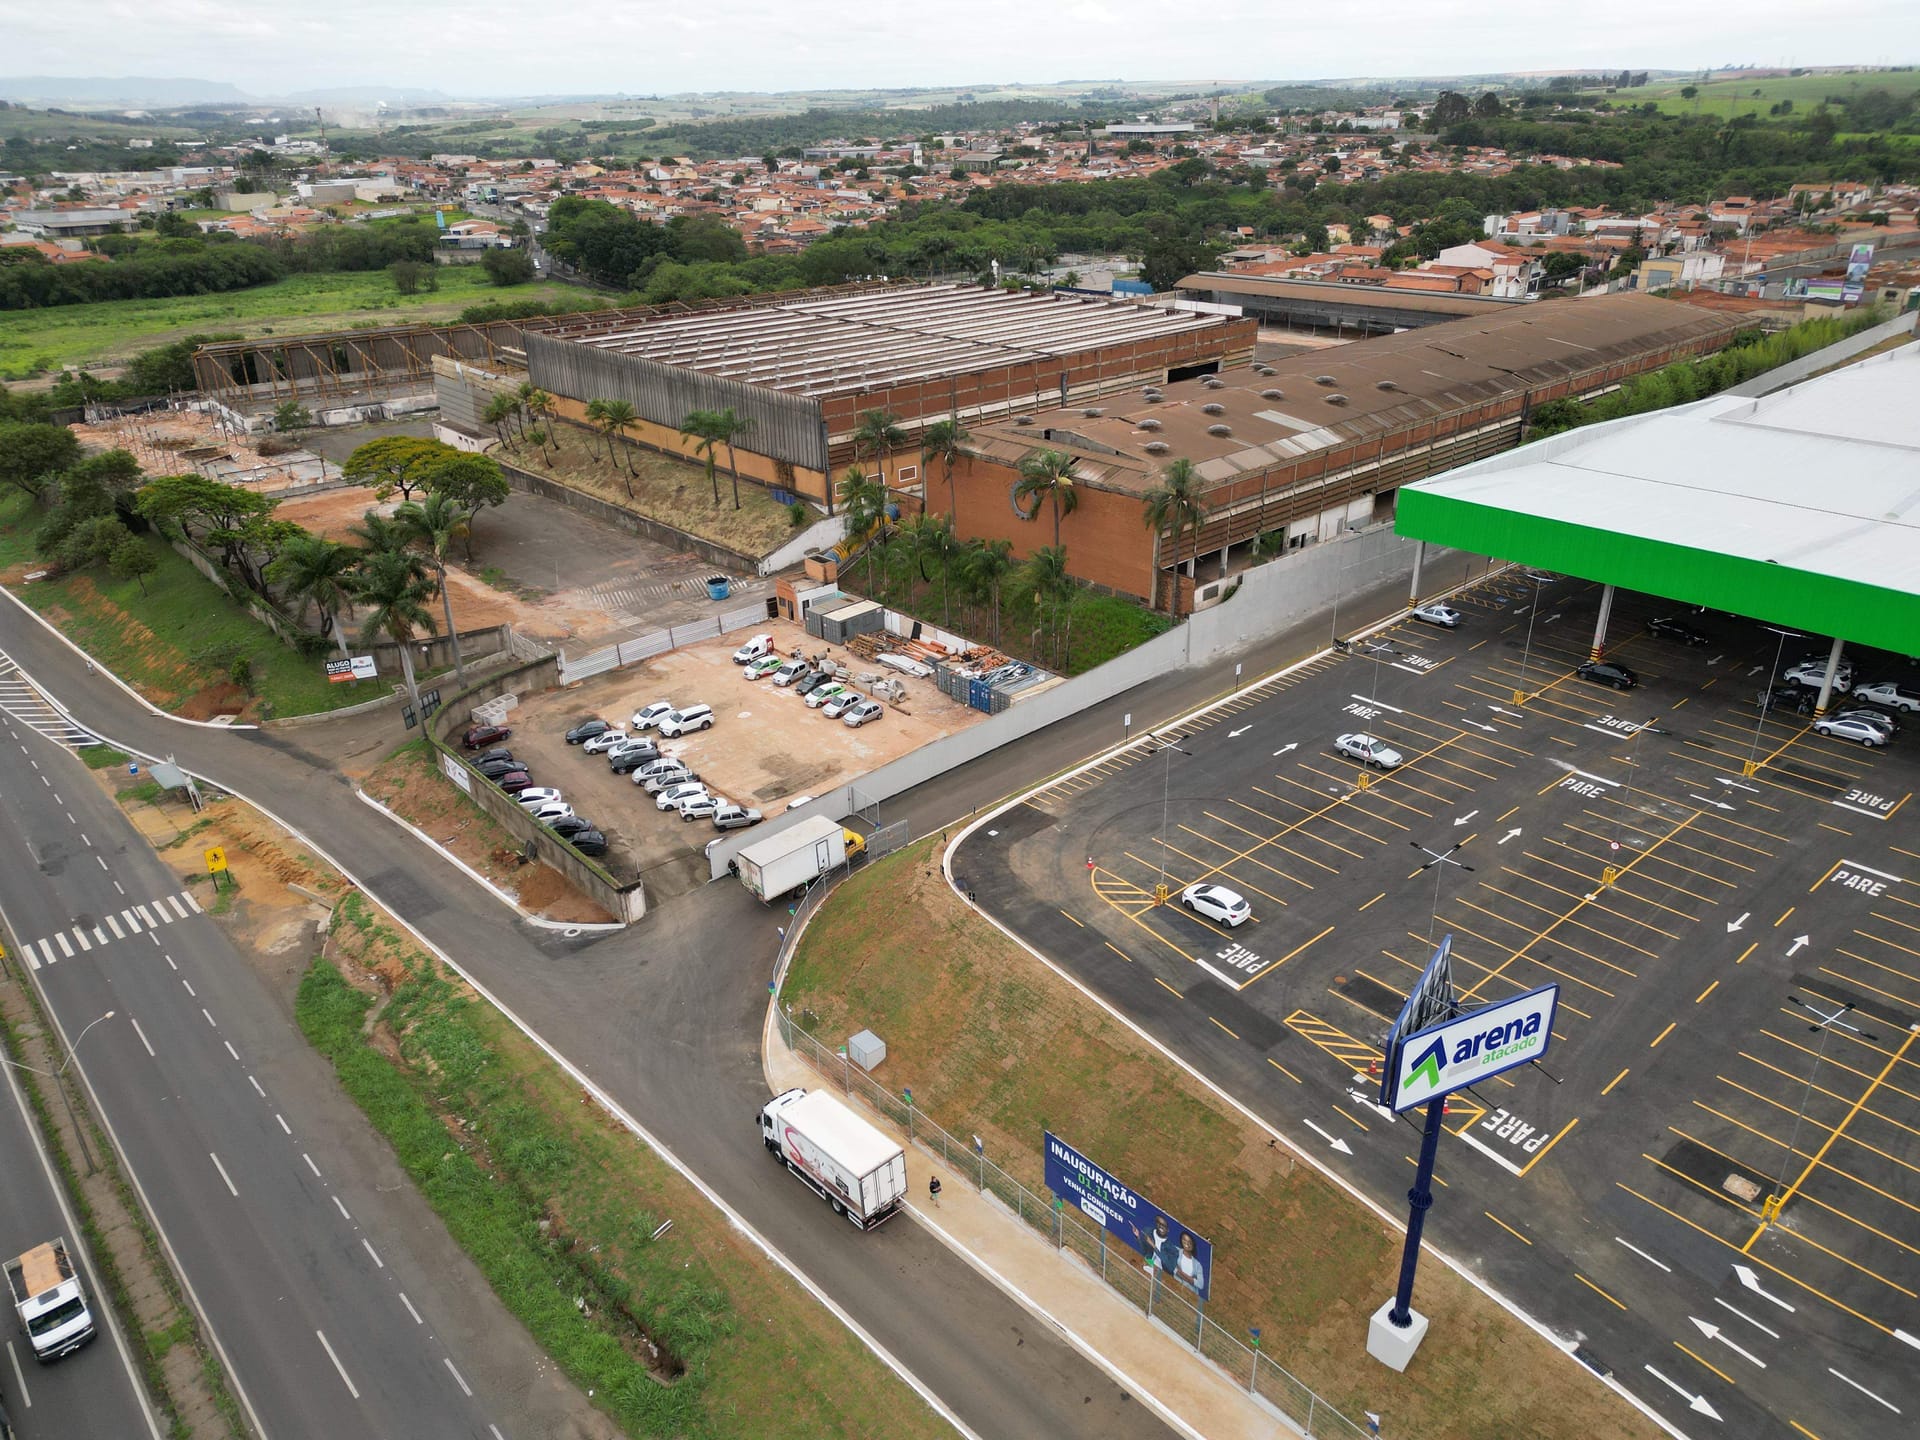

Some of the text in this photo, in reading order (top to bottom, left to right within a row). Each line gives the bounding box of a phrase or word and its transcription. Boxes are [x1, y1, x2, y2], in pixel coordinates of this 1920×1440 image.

[1402, 654, 1439, 670] PARE
[1342, 703, 1382, 720] PARE
[1597, 715, 1640, 732] PARE
[1559, 778, 1606, 799] PARE
[1845, 788, 1896, 812] PARE
[1830, 869, 1888, 897] PARE
[1215, 943, 1270, 974] PARE
[1452, 1011, 1541, 1065] arena
[1481, 1035, 1537, 1065] atacado
[1481, 1107, 1550, 1153] PARE
[1051, 1141, 1137, 1209] INAUGURAÇÃO
[1063, 1176, 1086, 1197] VENHA
[1086, 1192, 1124, 1224] CONHECER
